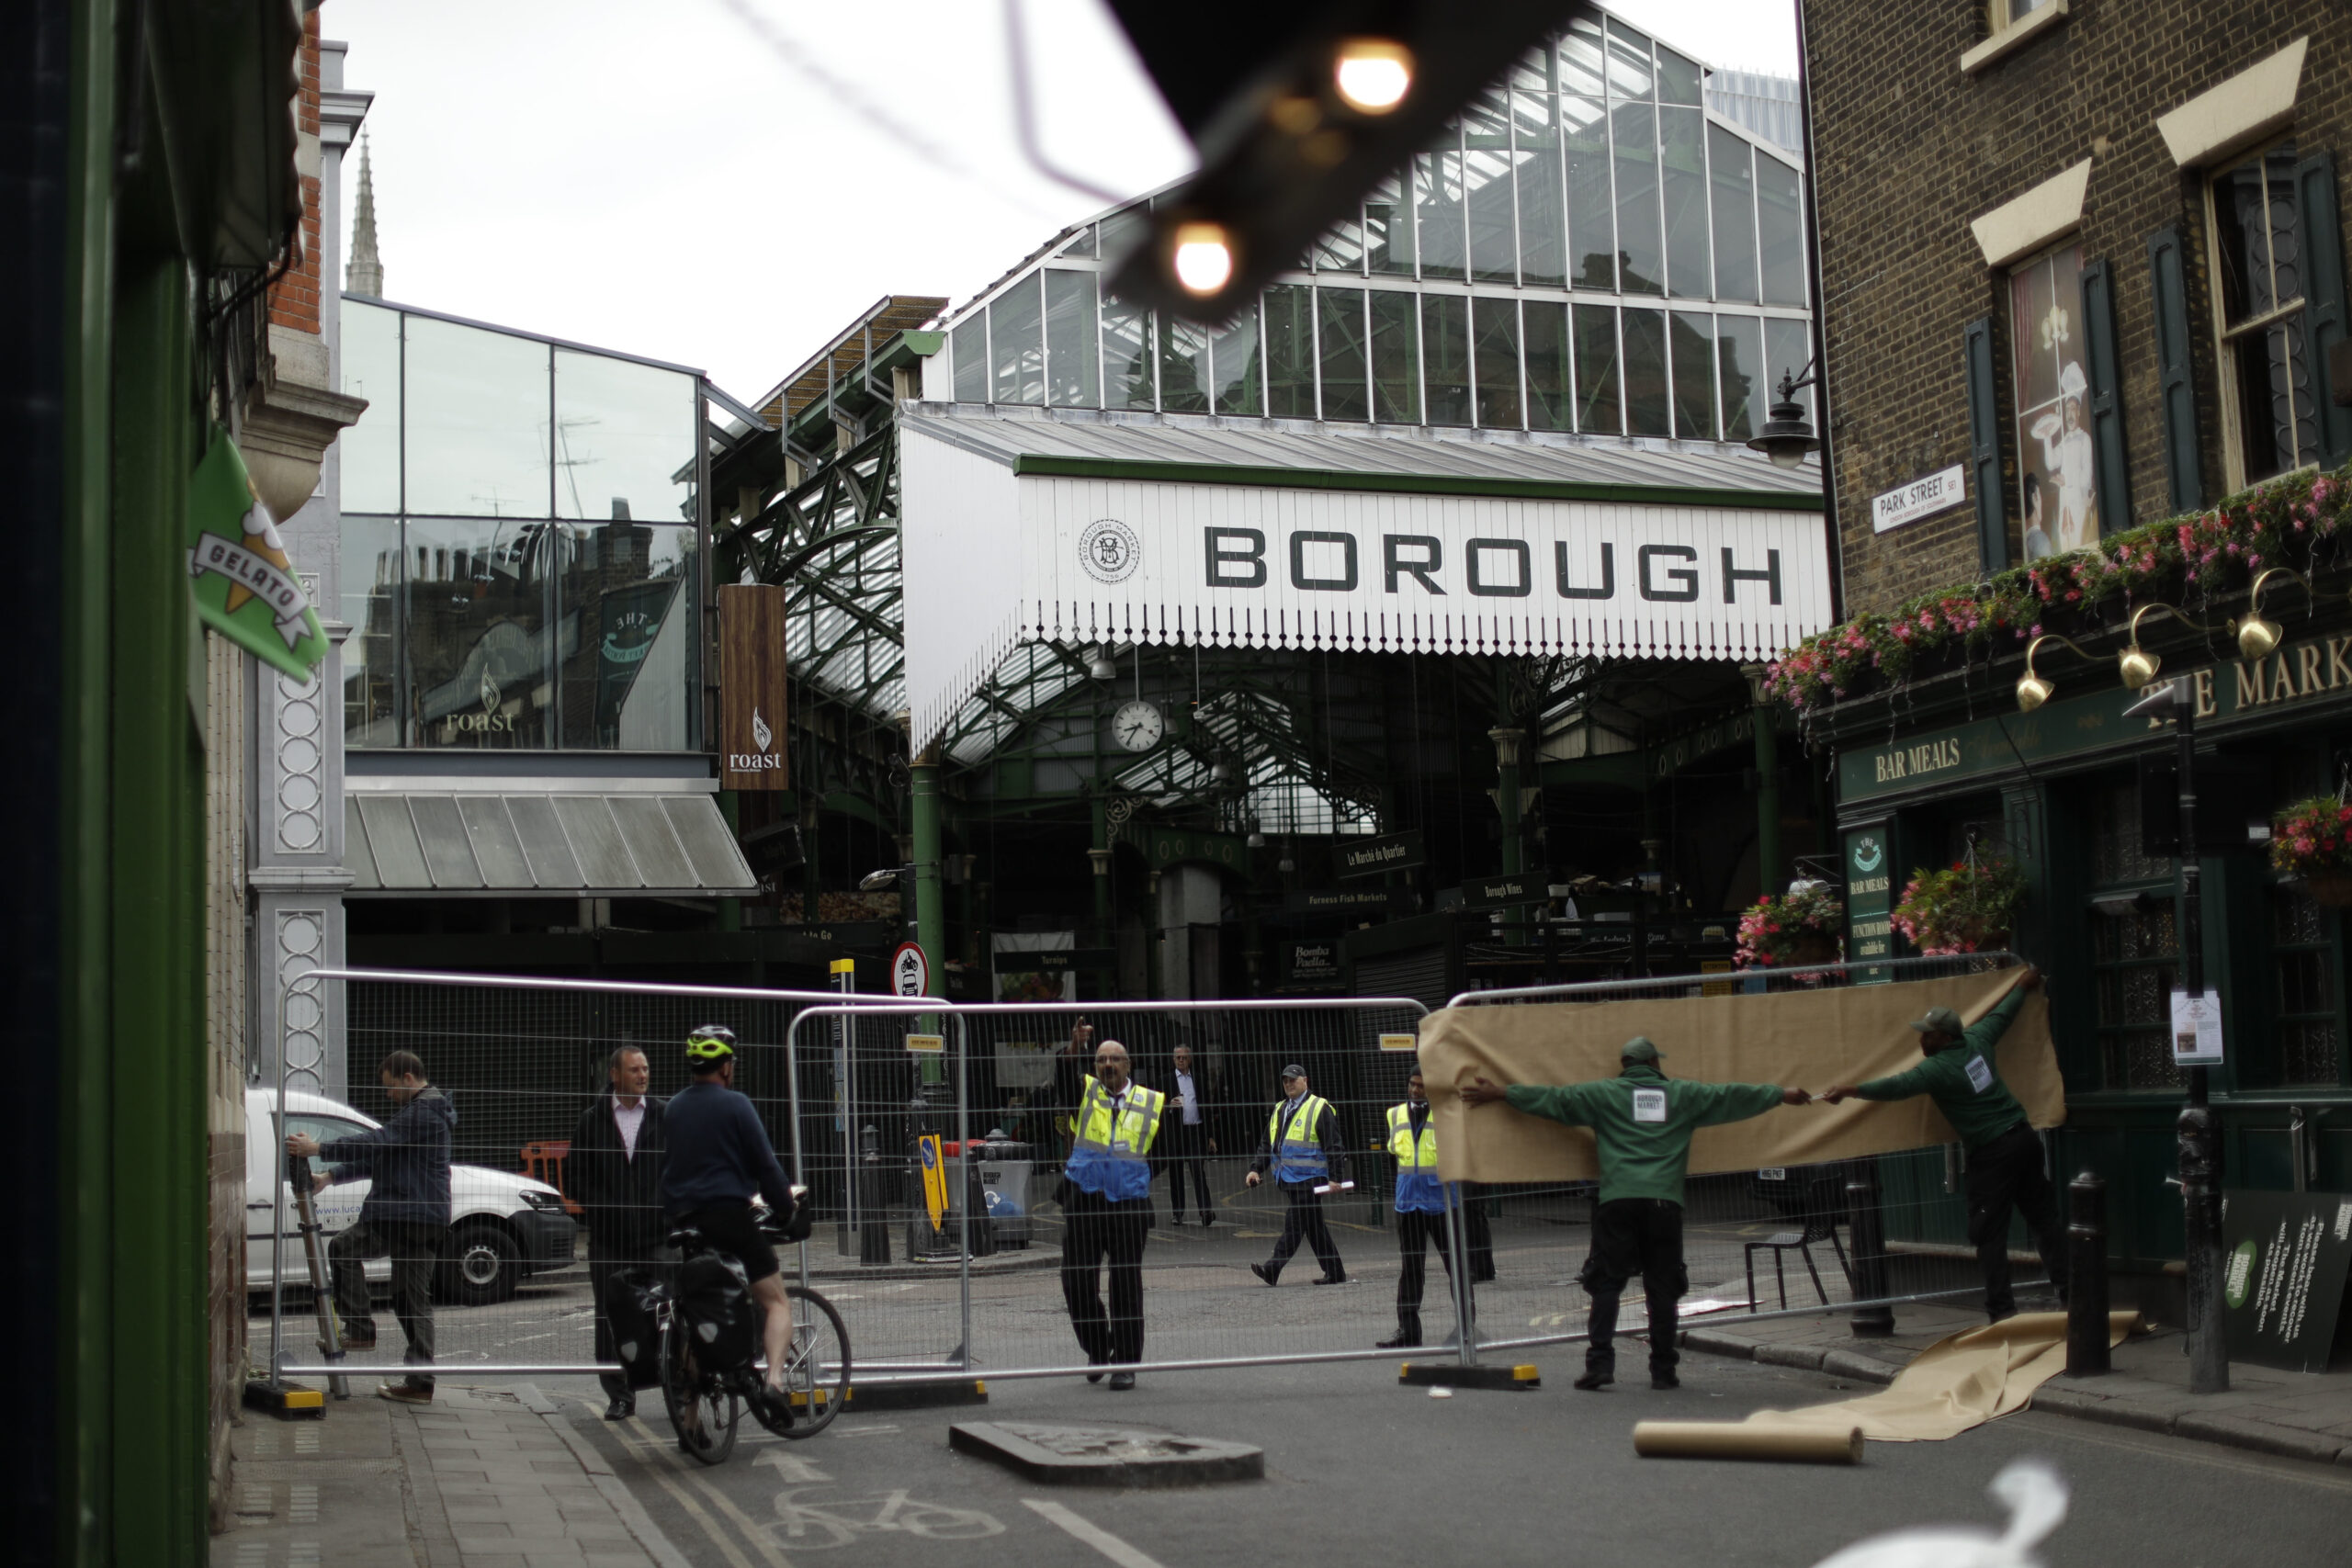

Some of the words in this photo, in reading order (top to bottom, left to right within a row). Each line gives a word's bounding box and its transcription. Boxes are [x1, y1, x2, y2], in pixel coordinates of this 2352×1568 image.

[1880, 491, 1906, 516] PARK
[1910, 477, 1943, 505] STREET
[1082, 523, 1112, 561] BOROUGH
[1115, 525, 1136, 562] MARKET
[209, 544, 296, 607] GELATO
[1204, 525, 1783, 606] BOROUGH
[446, 710, 514, 732] roast
[729, 752, 782, 769] roast
[1875, 751, 1905, 783] BAR
[1908, 737, 1960, 776] MEALS
[1347, 852, 1355, 866] Le
[1355, 848, 1375, 864] Marché
[1382, 843, 1407, 860] Quartier
[1309, 894, 1339, 905] Furness
[1339, 893, 1356, 904] Fish
[1356, 892, 1388, 903] Markets
[1485, 884, 1507, 898] Borough
[1507, 882, 1523, 896] Wines
[1850, 880, 1865, 896] BAR
[1865, 876, 1890, 893] MEALS
[1041, 954, 1068, 965] Turnips
[1295, 944, 1330, 957] Bomba
[2277, 1222, 2288, 1243] will
[2296, 1222, 2310, 1251] from
[2304, 1232, 2314, 1249] we
[2309, 1222, 2324, 1264] Please
[2267, 1242, 2276, 1257] as
[2279, 1244, 2291, 1269] The
[2227, 1253, 2243, 1293] MARKET
[2233, 1254, 2251, 1299] BOROUGH
[2267, 1245, 2282, 1285] reopen
[2288, 1253, 2301, 1292] recent
[2297, 1252, 2309, 1282] work
[2269, 1270, 2285, 1312] Market
[2294, 1285, 2303, 1297] to
[2302, 1266, 2316, 1293] bear
[2264, 1287, 2273, 1302] as
[2256, 1303, 2269, 1333] soon
[2296, 1295, 2308, 1321] with
[2284, 1299, 2299, 1344] recover
[2292, 1323, 2301, 1338] us
